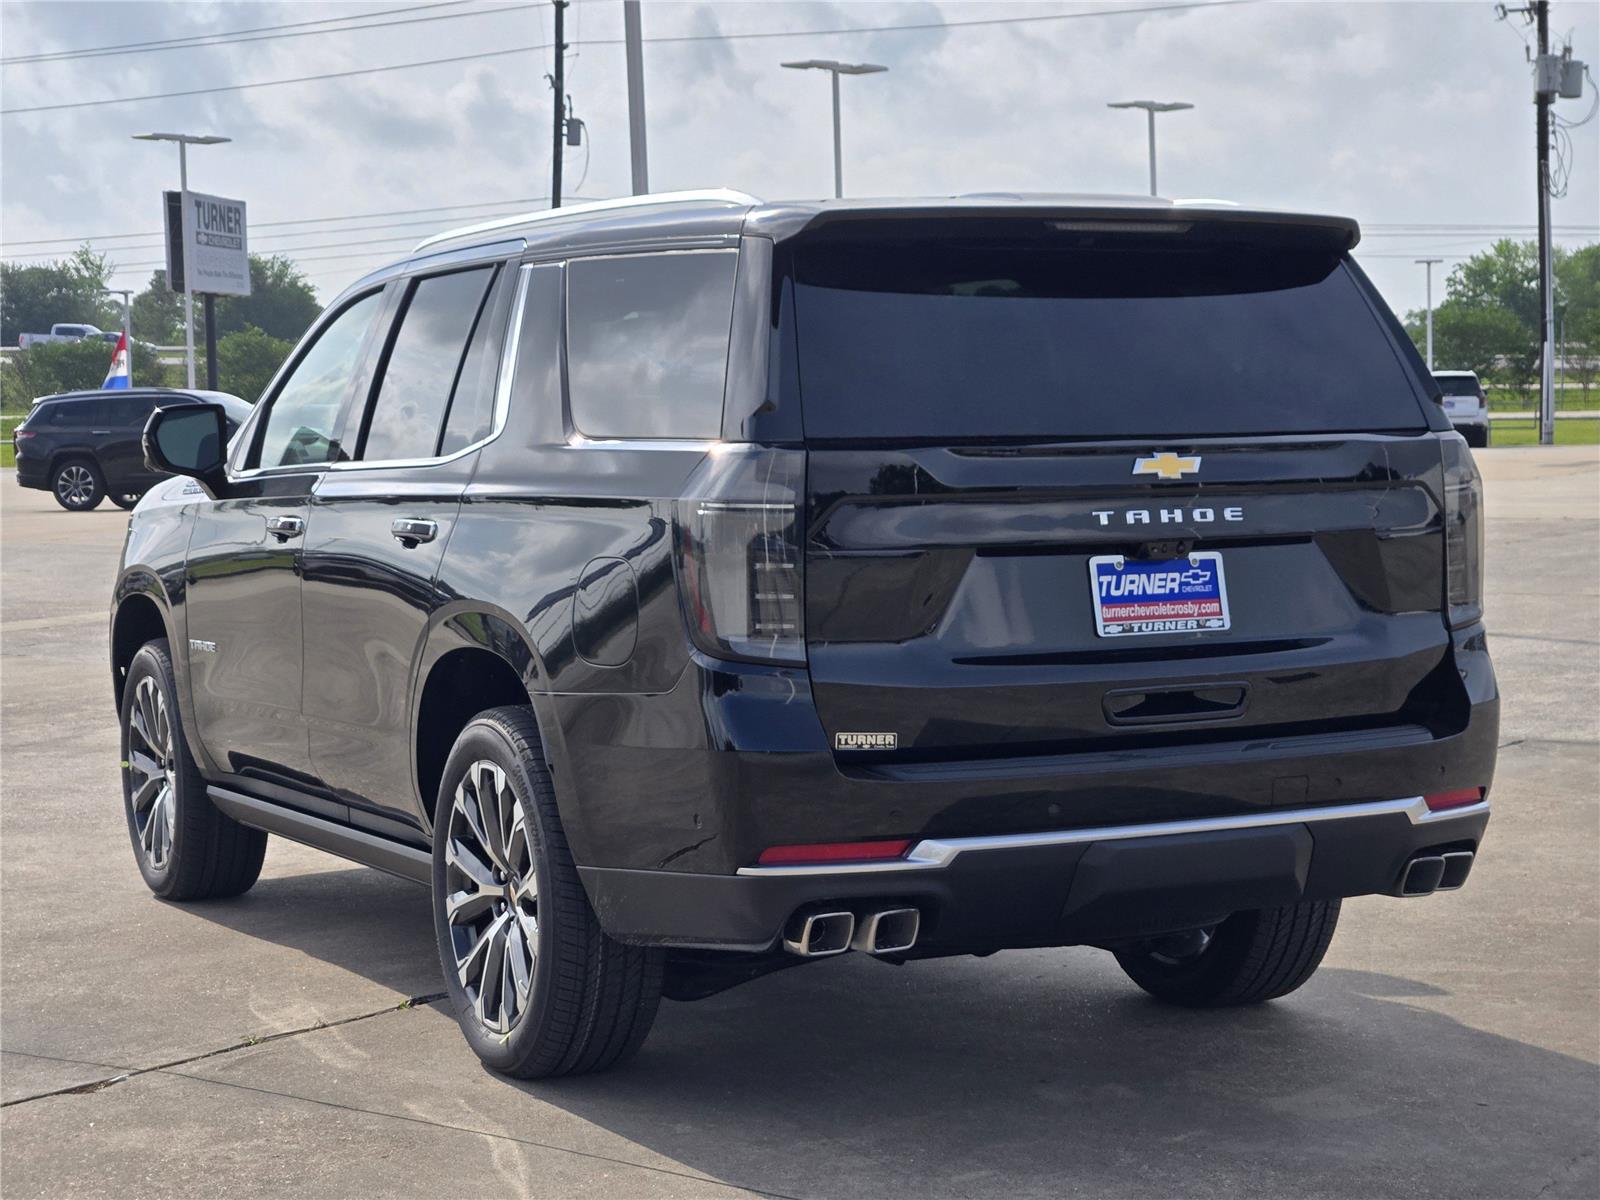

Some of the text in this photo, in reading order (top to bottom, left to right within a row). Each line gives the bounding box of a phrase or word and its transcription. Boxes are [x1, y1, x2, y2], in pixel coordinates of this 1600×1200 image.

[194, 199, 242, 235] TURNER
[1092, 507, 1244, 526] TAHOE
[1099, 572, 1180, 597] TURNER
[1103, 601, 1220, 618] turnerchevroletcrosby.com
[1131, 620, 1198, 632] TURNER
[838, 735, 895, 745] TURNER
